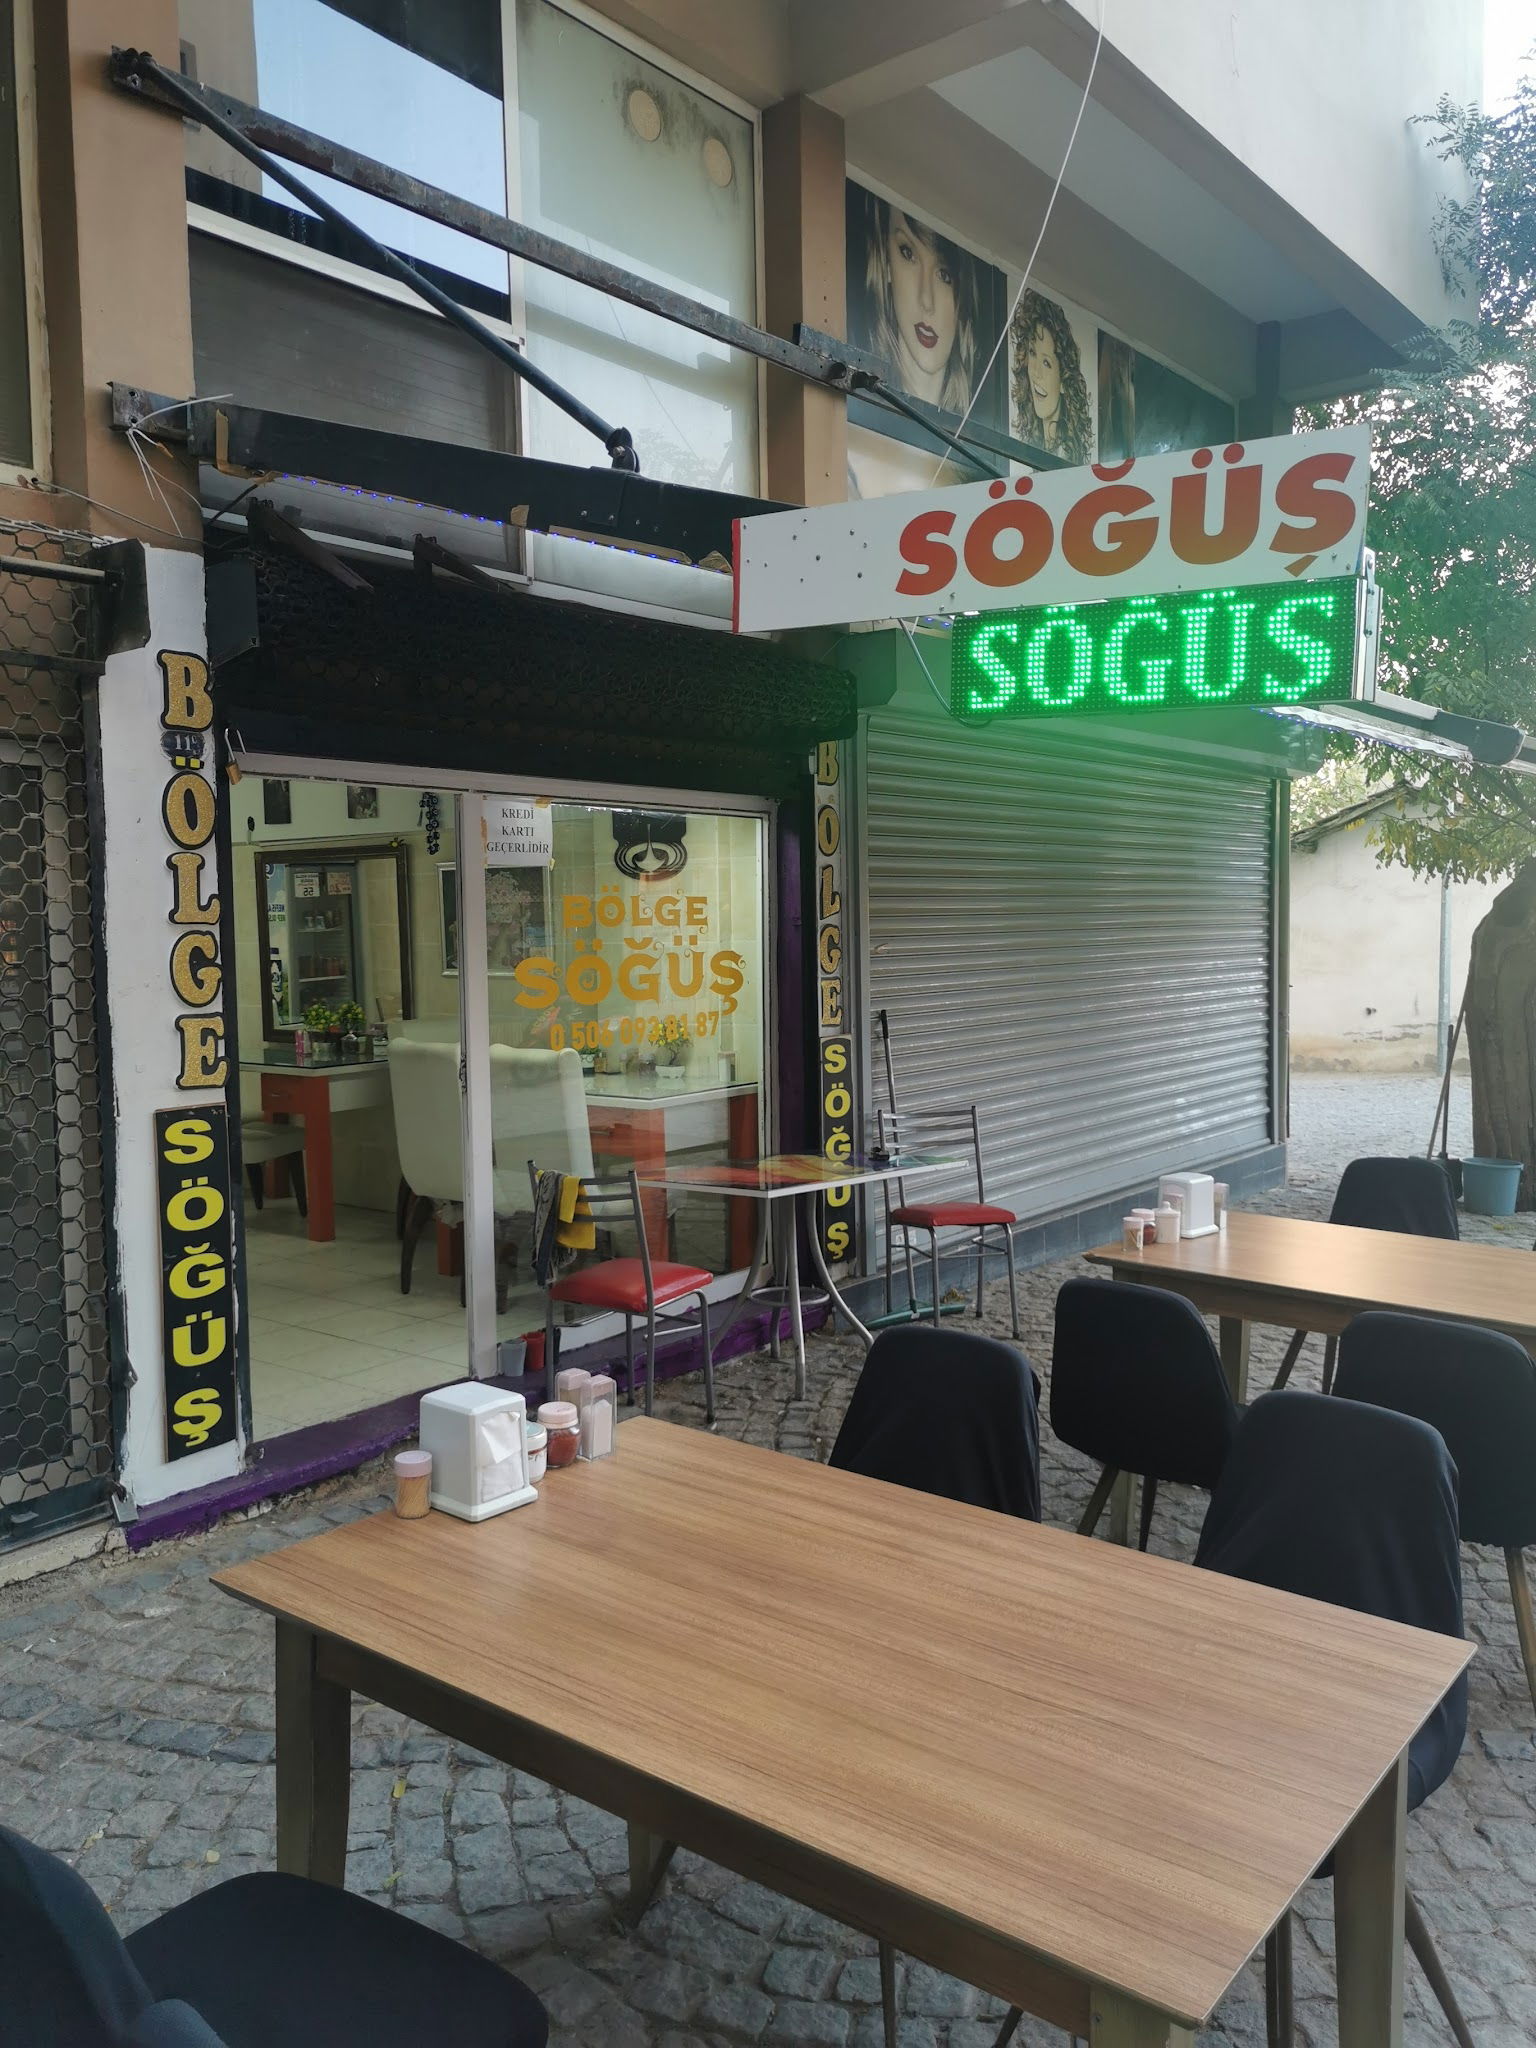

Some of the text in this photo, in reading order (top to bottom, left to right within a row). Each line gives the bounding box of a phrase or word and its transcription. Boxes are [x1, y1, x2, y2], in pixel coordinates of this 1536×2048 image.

[895, 443, 1357, 596] SÖĞÜŞ
[502, 807, 535, 819] KREDİ
[502, 826, 534, 836] KARTI
[486, 841, 549, 854] GEÇERLİDİR
[562, 885, 708, 931] BÖLGE
[513, 935, 746, 1016] SÖĞÜŞ
[550, 1023, 565, 1051] 0
[572, 1021, 614, 1049] 506
[696, 1011, 720, 1038] 87
[164, 1119, 226, 1447] SÖĞÜŞ
